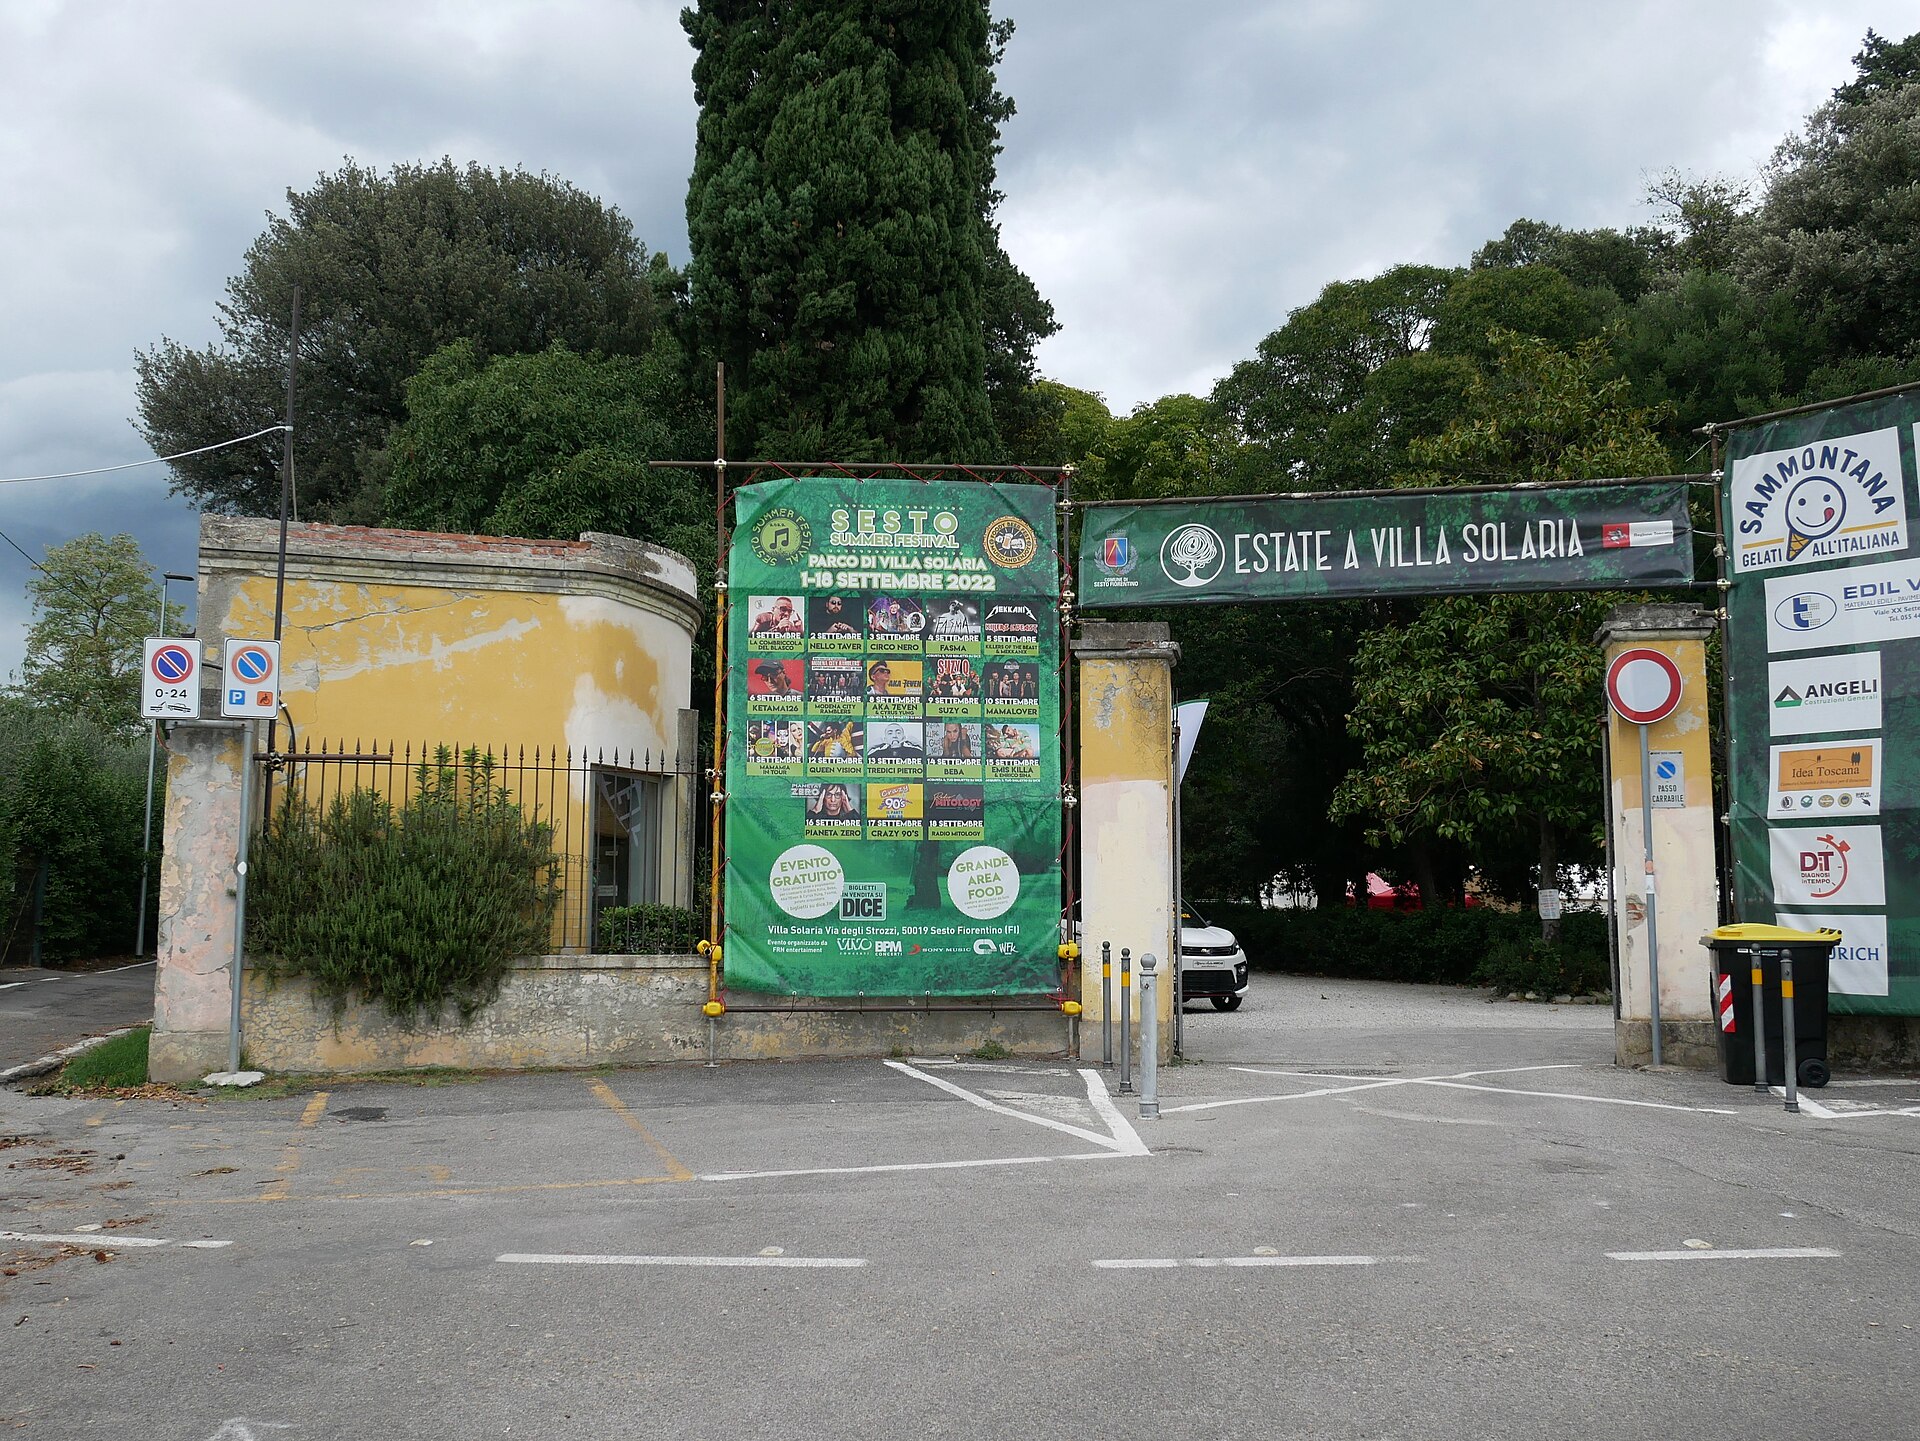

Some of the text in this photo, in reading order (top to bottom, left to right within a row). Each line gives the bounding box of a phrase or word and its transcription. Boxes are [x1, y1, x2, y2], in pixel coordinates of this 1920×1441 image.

[1738, 445, 1896, 534] SAMMONTANA
[752, 508, 794, 533] SUMMER
[830, 510, 959, 534] SESTO
[830, 532, 960, 549] SUMMER FESTIVAL
[1234, 518, 1584, 574] ESTATE A VILLA SOLARIA
[1742, 530, 1900, 568] GELATI ALL'ITALIANA
[808, 554, 989, 572] PARCO DI VILLA SOLARIA
[800, 571, 997, 592] 1-18 SETTEMBRE 2022
[1844, 582, 1900, 600] EDIL
[756, 631, 801, 639] SETTEMBRE
[817, 632, 862, 640] SETTEMBRE
[876, 633, 920, 641] SETTEMBRE
[934, 634, 979, 642] SETTEMBRE
[993, 635, 1037, 643] SETTEMBRE
[938, 659, 970, 675] SUZY Q
[155, 688, 188, 698] 0-24
[1805, 679, 1877, 699] ANGELI
[816, 695, 862, 703] SETTEMBRE
[876, 696, 920, 704] SETTEMBRE
[1804, 694, 1878, 706] Costruzioni Generali
[752, 704, 799, 712] KETAMA126
[872, 703, 918, 711] AKA 7EVEN
[960, 707, 969, 715] Q
[877, 757, 922, 765] SETTEMBRE
[937, 758, 982, 766] SETTEMBRE
[1792, 765, 1860, 778] Idea Toscana
[791, 788, 820, 796] ZERO
[1657, 784, 1677, 792] PASSO
[935, 798, 981, 807] MITOLOGY
[1651, 794, 1684, 803] CARRABILE
[815, 819, 861, 827] SETTEMBRE
[805, 829, 861, 837] PIANETA ZERO
[780, 856, 831, 872] EVENTO
[955, 856, 1009, 873] GRANDE
[1800, 851, 1834, 872] DiT
[968, 872, 1001, 886] AREA
[968, 885, 1004, 900] FOOD
[842, 898, 883, 917] DICE
[767, 924, 1020, 937] Villa Solaria Via degli Strozzi, 50019 Sesto Fiorentino (FI)
[787, 939, 820, 947] organizzato
[875, 940, 902, 952] BPM
[1829, 947, 1879, 961] URICH
